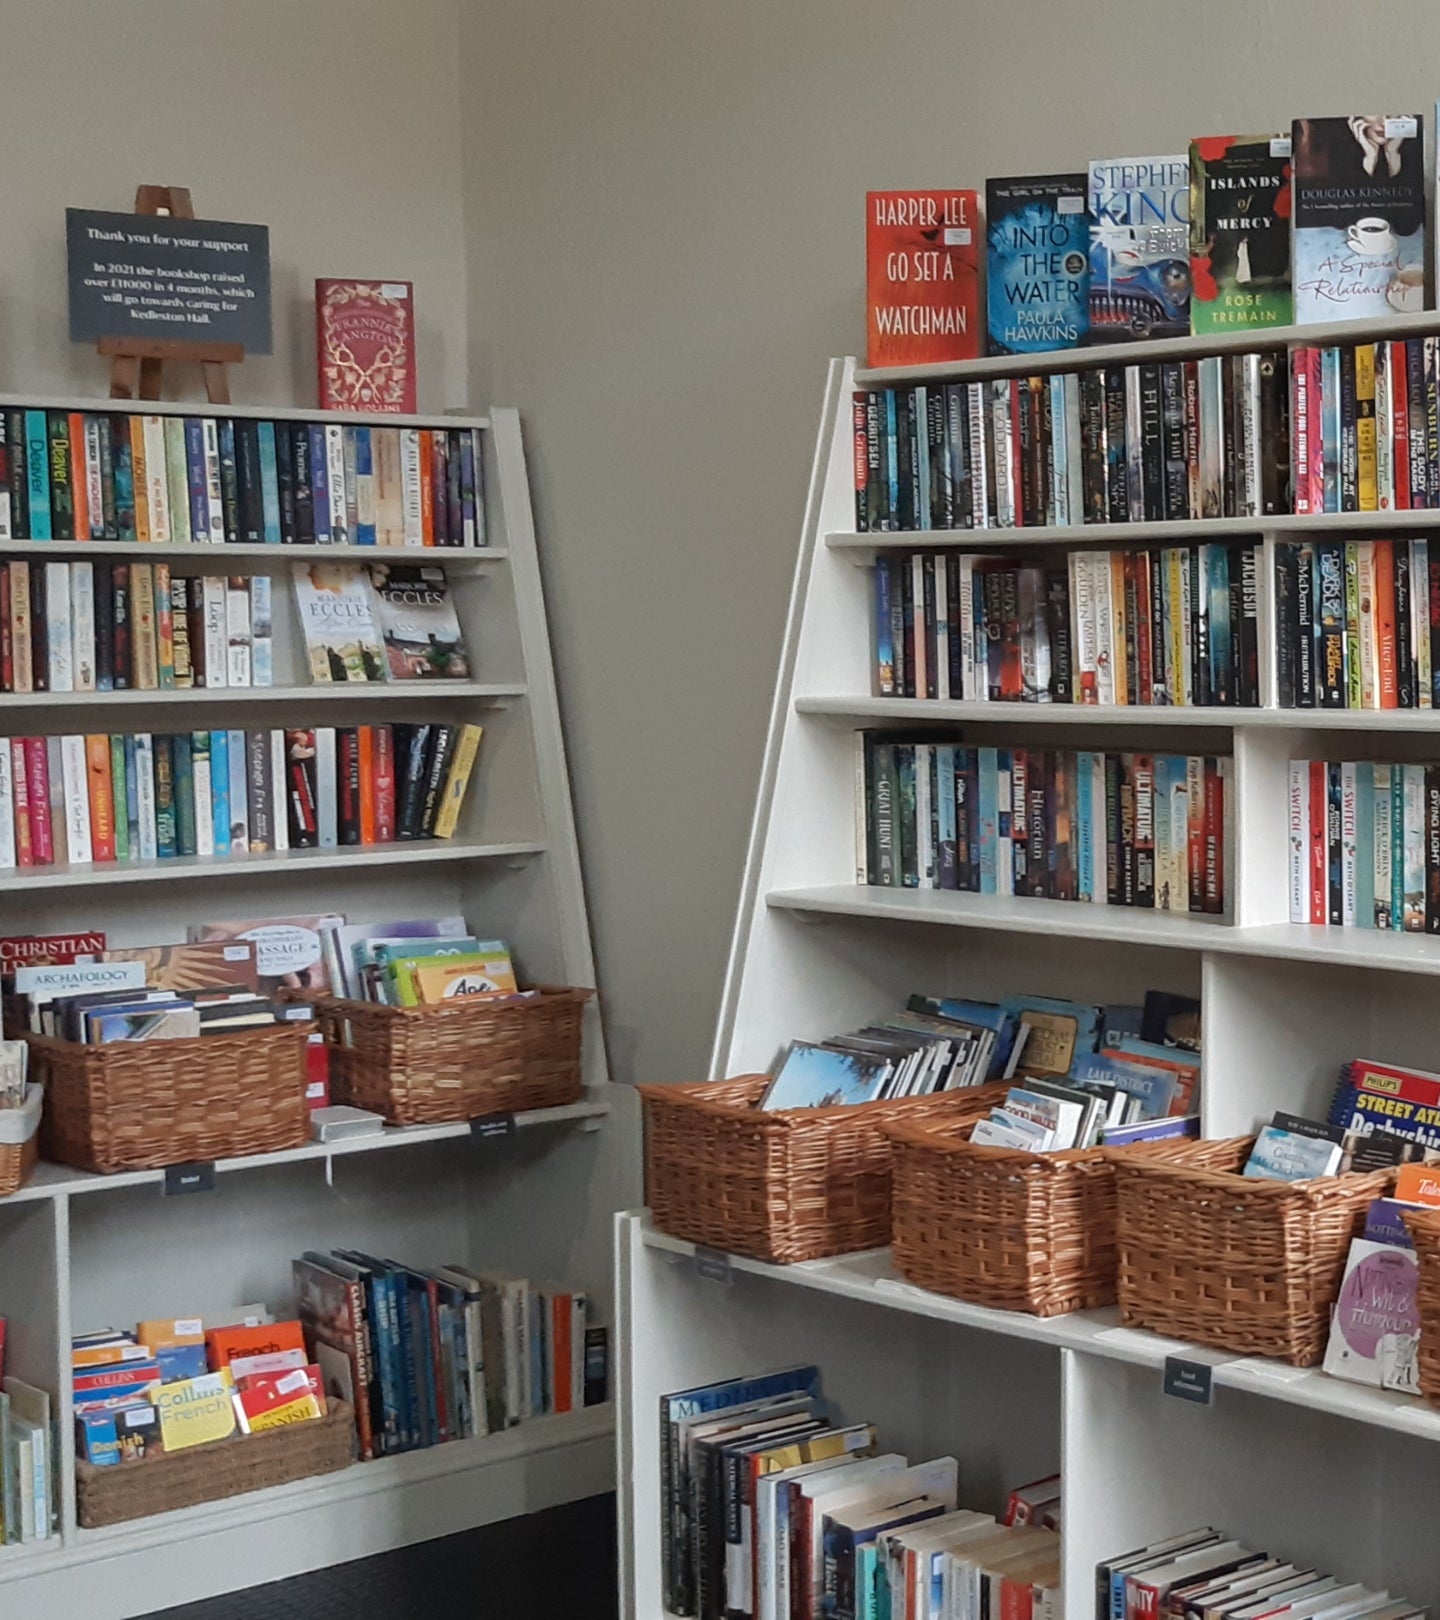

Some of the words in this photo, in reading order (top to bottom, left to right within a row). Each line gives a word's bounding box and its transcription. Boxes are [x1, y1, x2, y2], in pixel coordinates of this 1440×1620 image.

[1211, 175, 1280, 191] ISLANDS
[1301, 189, 1356, 199] DOUGLAS
[1359, 187, 1412, 197] KENNEDY
[876, 197, 937, 227] HARPER
[943, 195, 967, 226] LEE
[1237, 194, 1253, 213] of
[1216, 216, 1273, 230] MERCY
[87, 228, 125, 243] Thank
[128, 234, 150, 244] you
[153, 234, 169, 245] for
[173, 238, 200, 248] your
[203, 241, 249, 252] support
[1012, 226, 1070, 247] INTO
[94, 262, 106, 272] In
[108, 264, 134, 275] 2021
[136, 267, 155, 276] the
[157, 268, 210, 283] bookshop
[212, 272, 245, 283] raised
[887, 253, 909, 281] GO
[913, 251, 941, 282] SET
[942, 251, 954, 280] A
[1021, 252, 1060, 276] THE
[1318, 257, 1332, 272] A
[1340, 254, 1406, 277] Special
[84, 279, 108, 287] over
[154, 281, 164, 291] in
[167, 283, 173, 292] 4
[177, 284, 220, 296] months,
[222, 288, 255, 298] which
[1005, 279, 1079, 304] WATER
[1298, 279, 1410, 302] Relationship
[102, 293, 122, 302] will
[124, 296, 138, 305] go
[140, 296, 184, 308] towards
[186, 301, 220, 311] caring
[222, 301, 238, 311] for
[1225, 295, 1262, 308] ROSE
[131, 310, 185, 322] Kedleston
[876, 306, 967, 335] WATCHMAN
[1017, 308, 1064, 326] PAULA
[1211, 310, 1277, 323] TREMAIN
[1005, 323, 1077, 342] HAWKINS
[868, 406, 879, 468] GERRITSEN
[29, 440, 45, 494] Deaver
[52, 439, 70, 484] Deaver
[381, 590, 442, 605] ECCLES
[0, 938, 103, 959] CHRISTIAN
[36, 970, 128, 984] ARCHAEOLOGY
[1367, 1076, 1398, 1090] PHILIP'S
[1356, 1094, 1415, 1119] STREET
[351, 1285, 363, 1330] CLASSIC
[353, 1332, 367, 1387] AIRCRAFT
[93, 1372, 136, 1387] COLLINS
[160, 1400, 229, 1423] French
